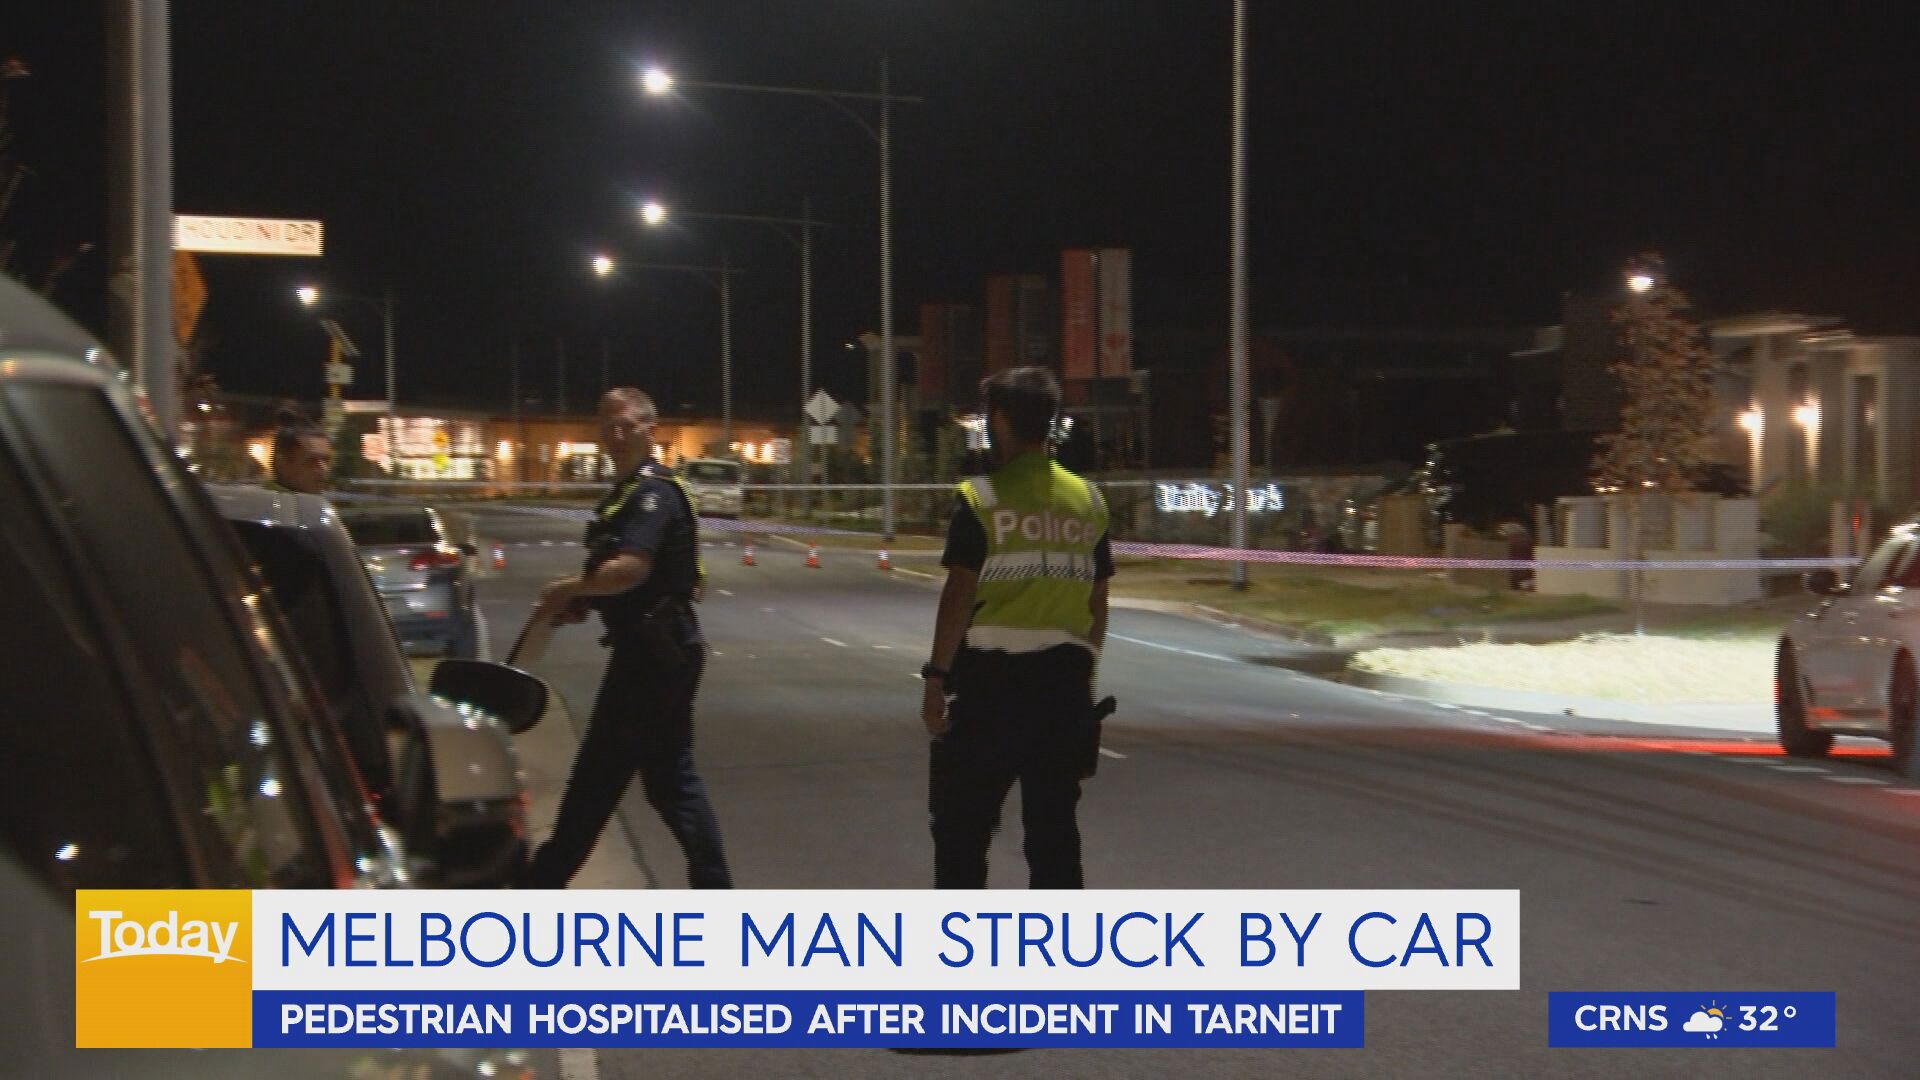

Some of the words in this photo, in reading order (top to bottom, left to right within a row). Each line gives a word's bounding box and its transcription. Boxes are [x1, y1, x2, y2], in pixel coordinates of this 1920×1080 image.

[183, 219, 281, 242] HOUDINI
[285, 221, 318, 243] DR
[991, 509, 1095, 545] Police
